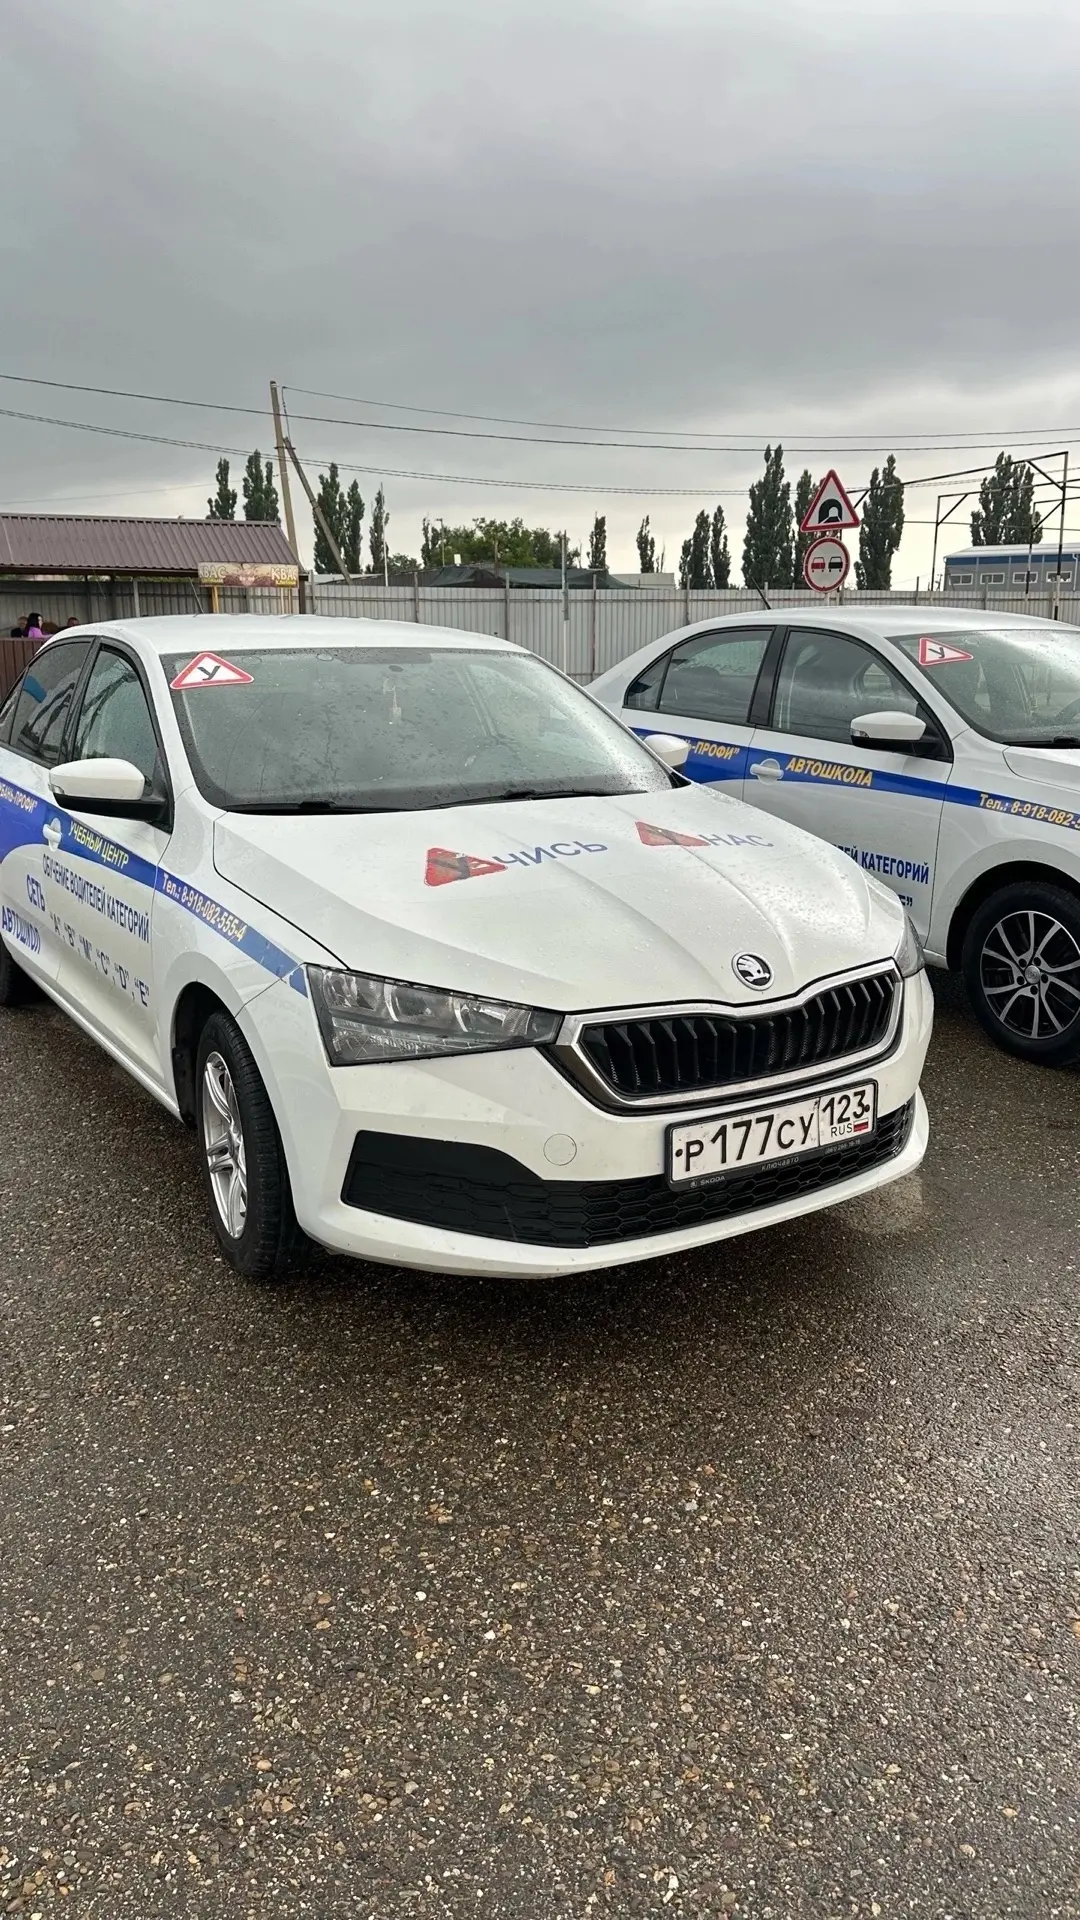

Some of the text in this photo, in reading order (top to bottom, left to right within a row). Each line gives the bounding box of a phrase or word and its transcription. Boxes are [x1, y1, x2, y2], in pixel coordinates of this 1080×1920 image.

[928, 647, 945, 659] У
[197, 666, 221, 681] У
[684, 739, 740, 760] -ПРОФИ”
[785, 757, 873, 787] АВТОШКОЛА
[70, 820, 129, 869] УЧЕБНЫЙ ЦЕНТР
[698, 834, 774, 848] НАС
[861, 851, 930, 885] КАТЕГОРИЙ
[27, 874, 45, 912] СЕТЬ
[70, 870, 105, 915] ВОДИТЕЛЕЙ
[106, 895, 150, 943] КАТЕГОРИЙ
[1, 905, 41, 954] АВТОШКОЛ
[181, 883, 247, 942] 8-918-082-555-4
[822, 1090, 867, 1126] 123
[830, 1123, 853, 1138] RUS
